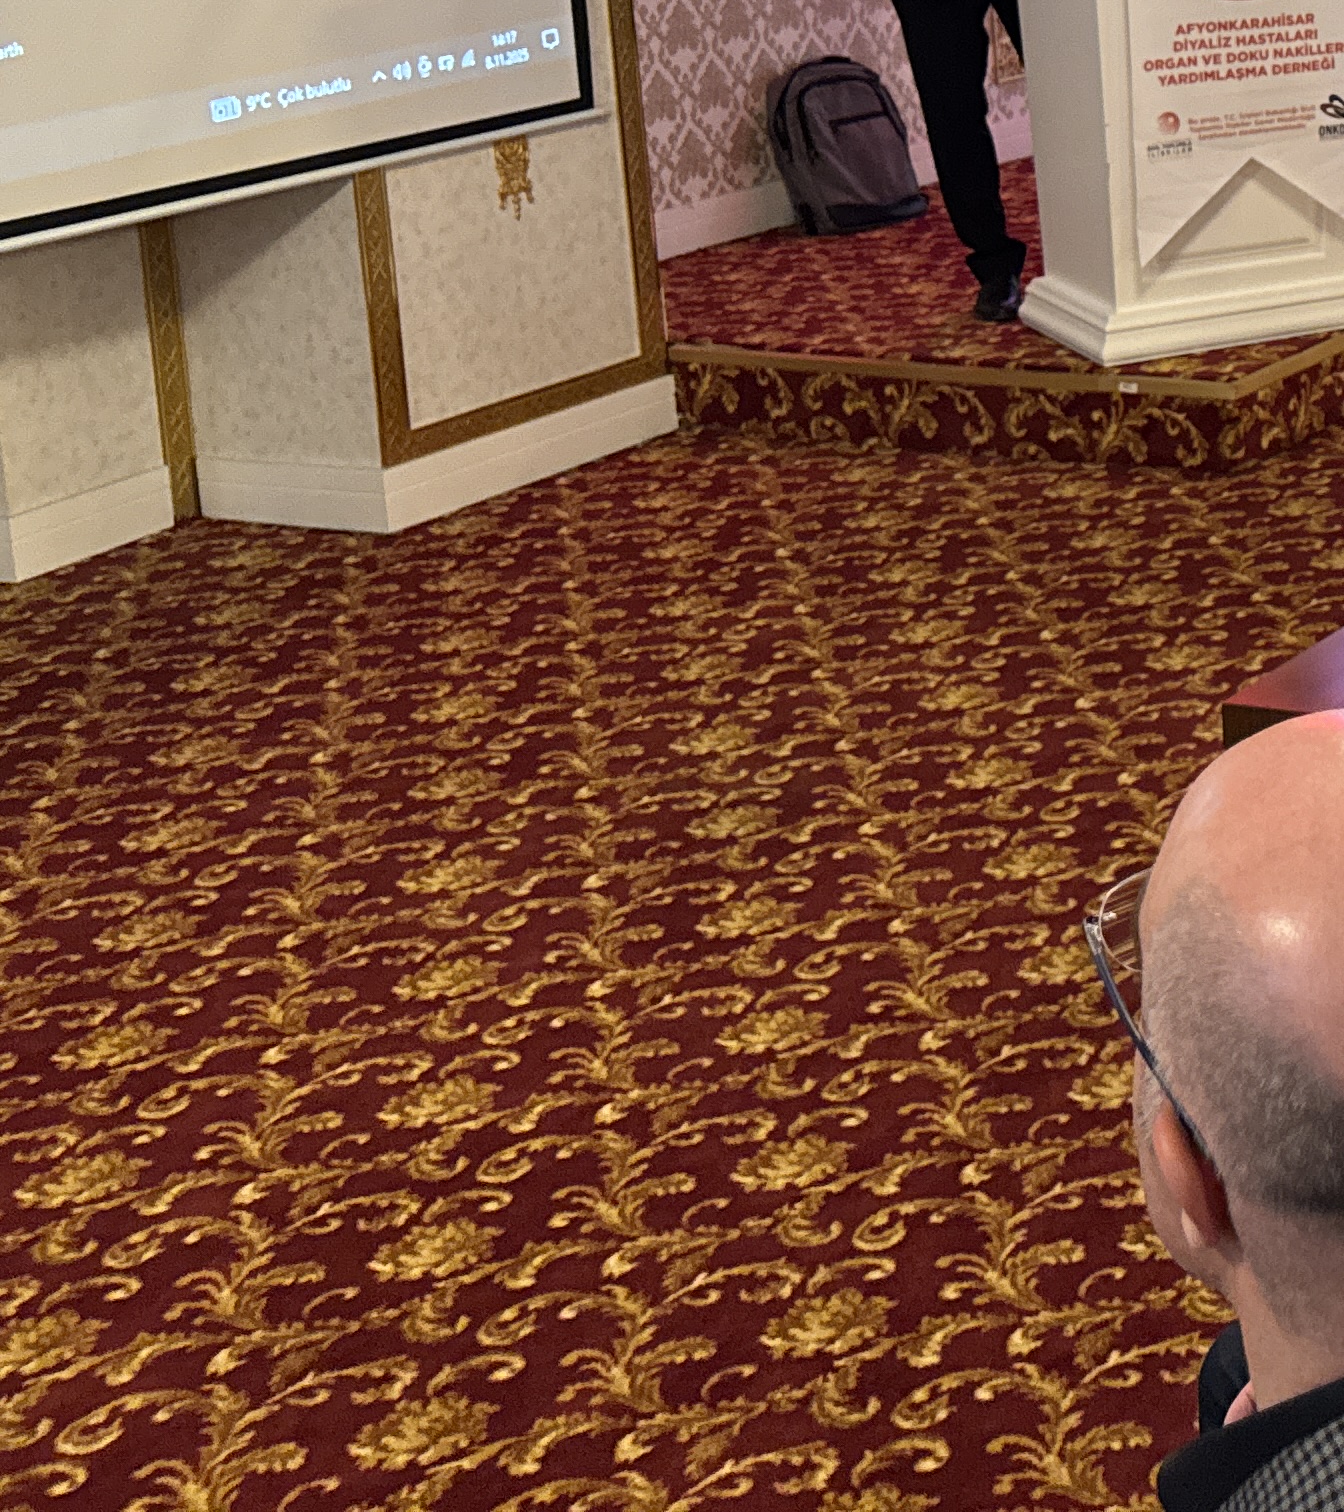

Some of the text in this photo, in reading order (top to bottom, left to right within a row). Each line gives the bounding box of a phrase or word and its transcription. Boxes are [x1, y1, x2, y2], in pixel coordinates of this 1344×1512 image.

[1175, 12, 1315, 36] AFYONKARAHİSAR
[1173, 29, 1318, 53] DİYALİZ HASTALARI
[1143, 55, 1197, 72] ORGAN
[1202, 53, 1222, 65] VE
[1226, 50, 1269, 64] DOKU
[1158, 55, 1335, 87] YARDIMLAŞMA DERNEĞİ
[246, 77, 352, 112] 9°C Çok bulutlu
